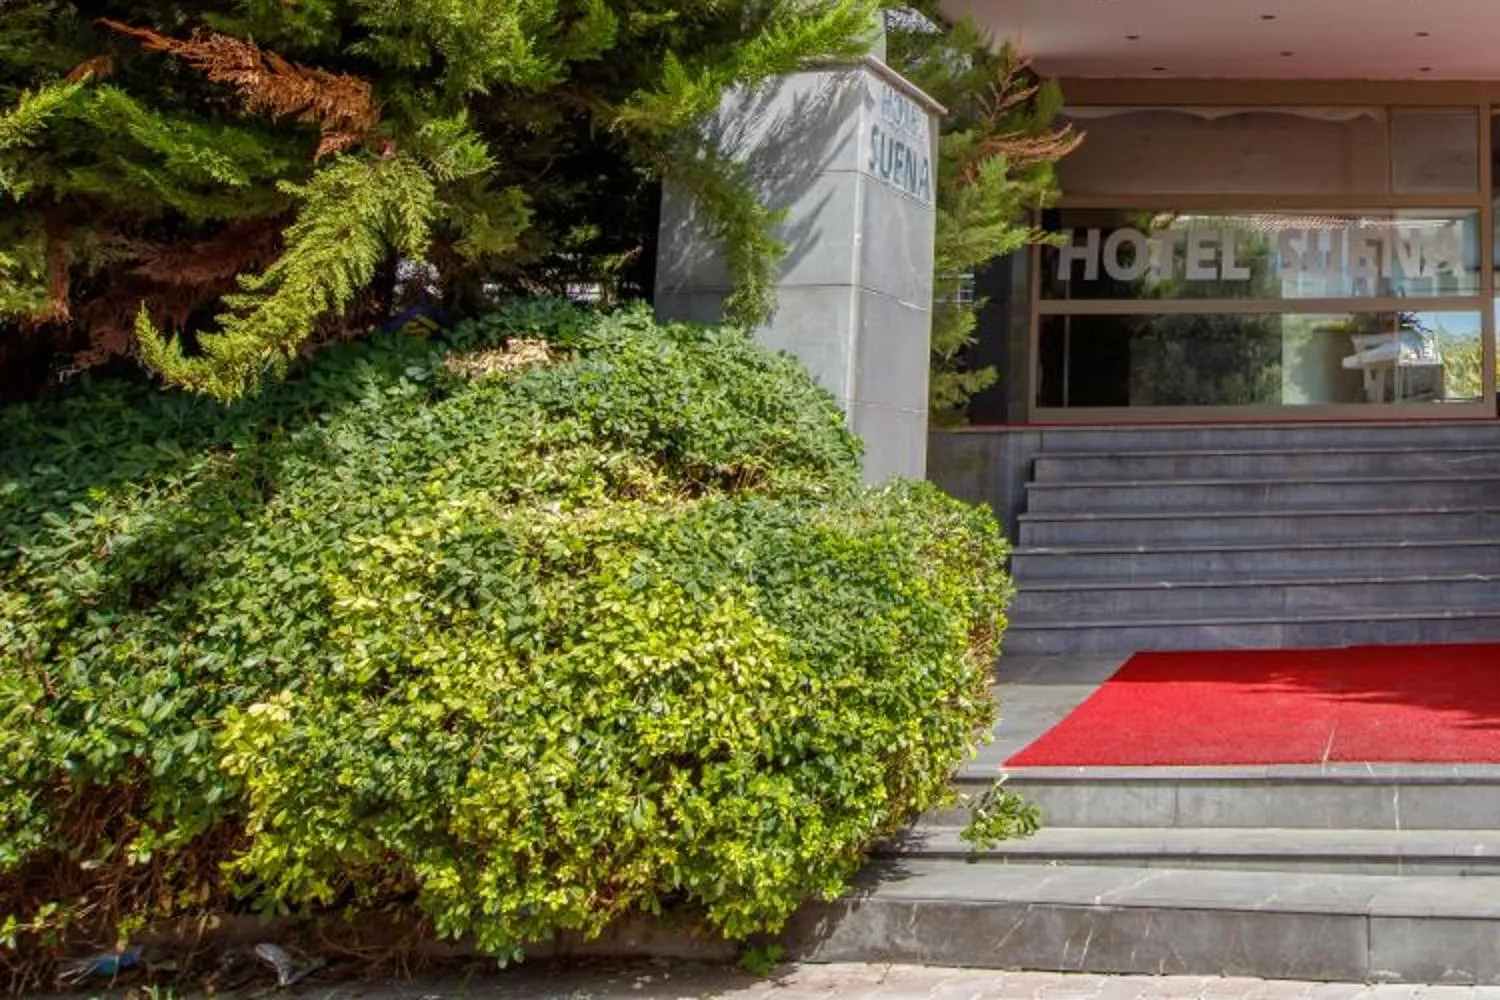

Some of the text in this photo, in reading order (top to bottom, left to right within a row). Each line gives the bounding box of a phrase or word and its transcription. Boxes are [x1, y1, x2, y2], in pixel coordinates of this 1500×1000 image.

[869, 123, 931, 201] SUENA
[1057, 226, 1466, 281] HOTEL SUENA
